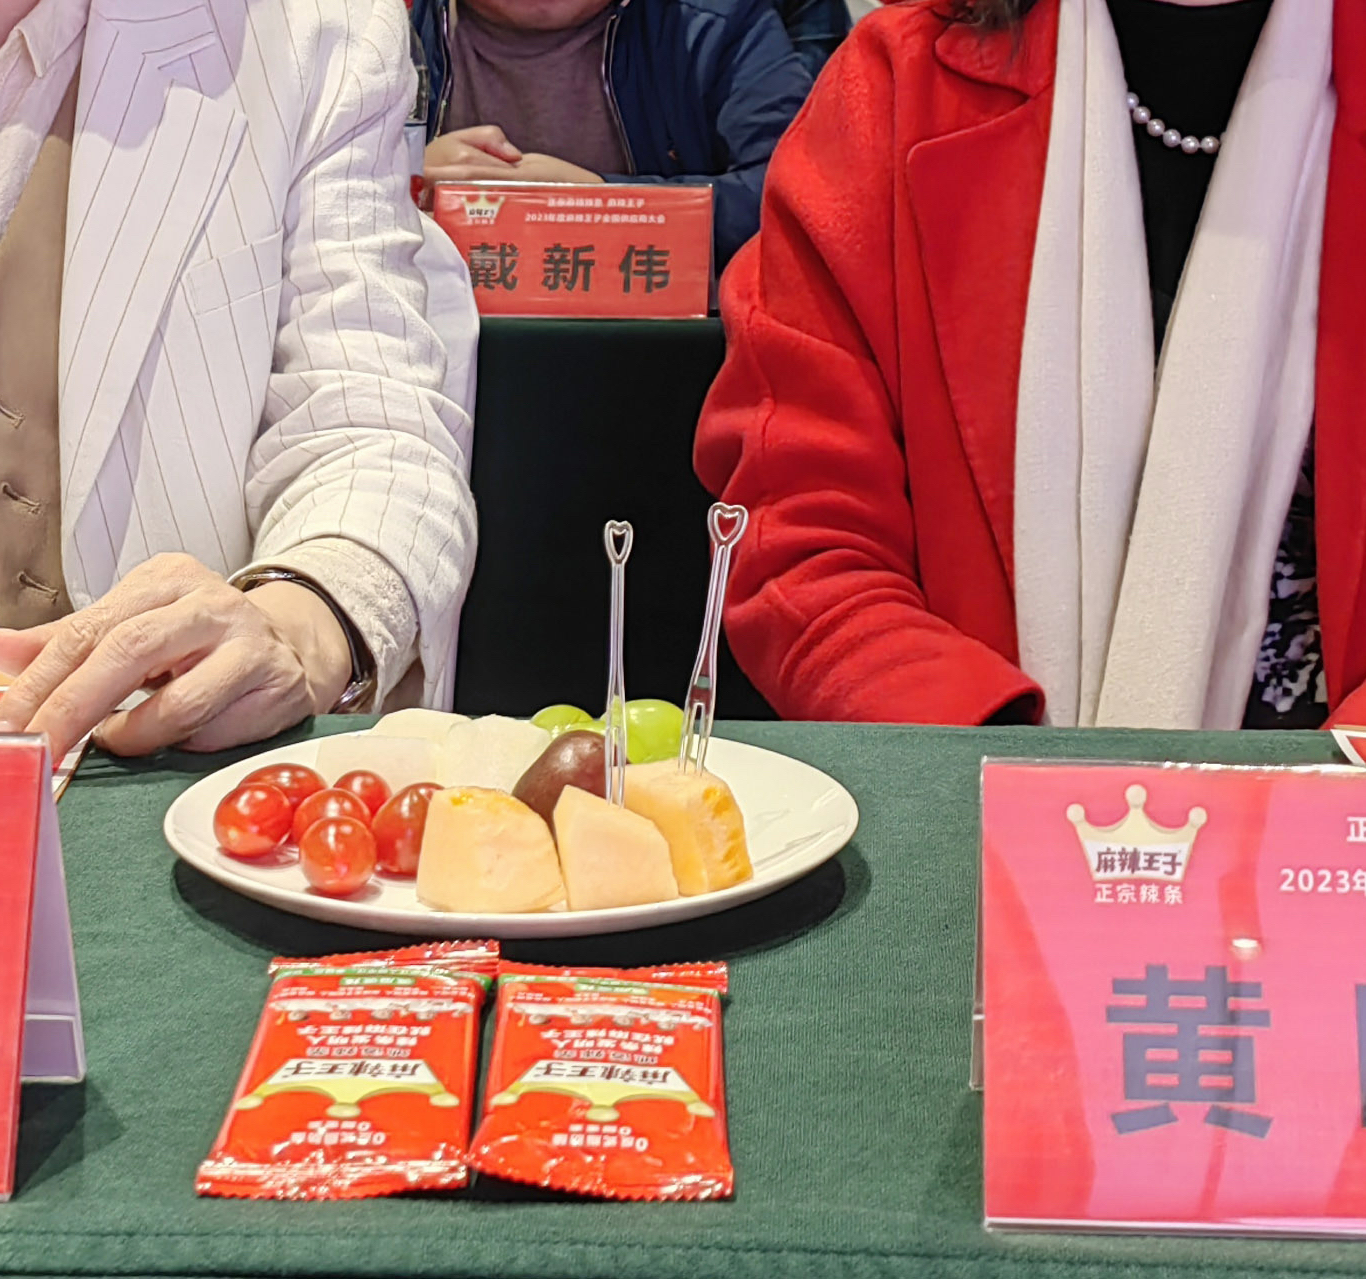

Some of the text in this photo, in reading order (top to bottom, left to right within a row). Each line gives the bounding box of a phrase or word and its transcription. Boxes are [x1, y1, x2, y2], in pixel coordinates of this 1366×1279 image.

[469, 243, 670, 293] 戴新伟
[1095, 847, 1182, 875] 麻辣王子
[1095, 883, 1183, 904] 正宗辣条
[284, 1060, 422, 1080] 麻辣王子
[533, 1062, 671, 1085] 麻辣王子
